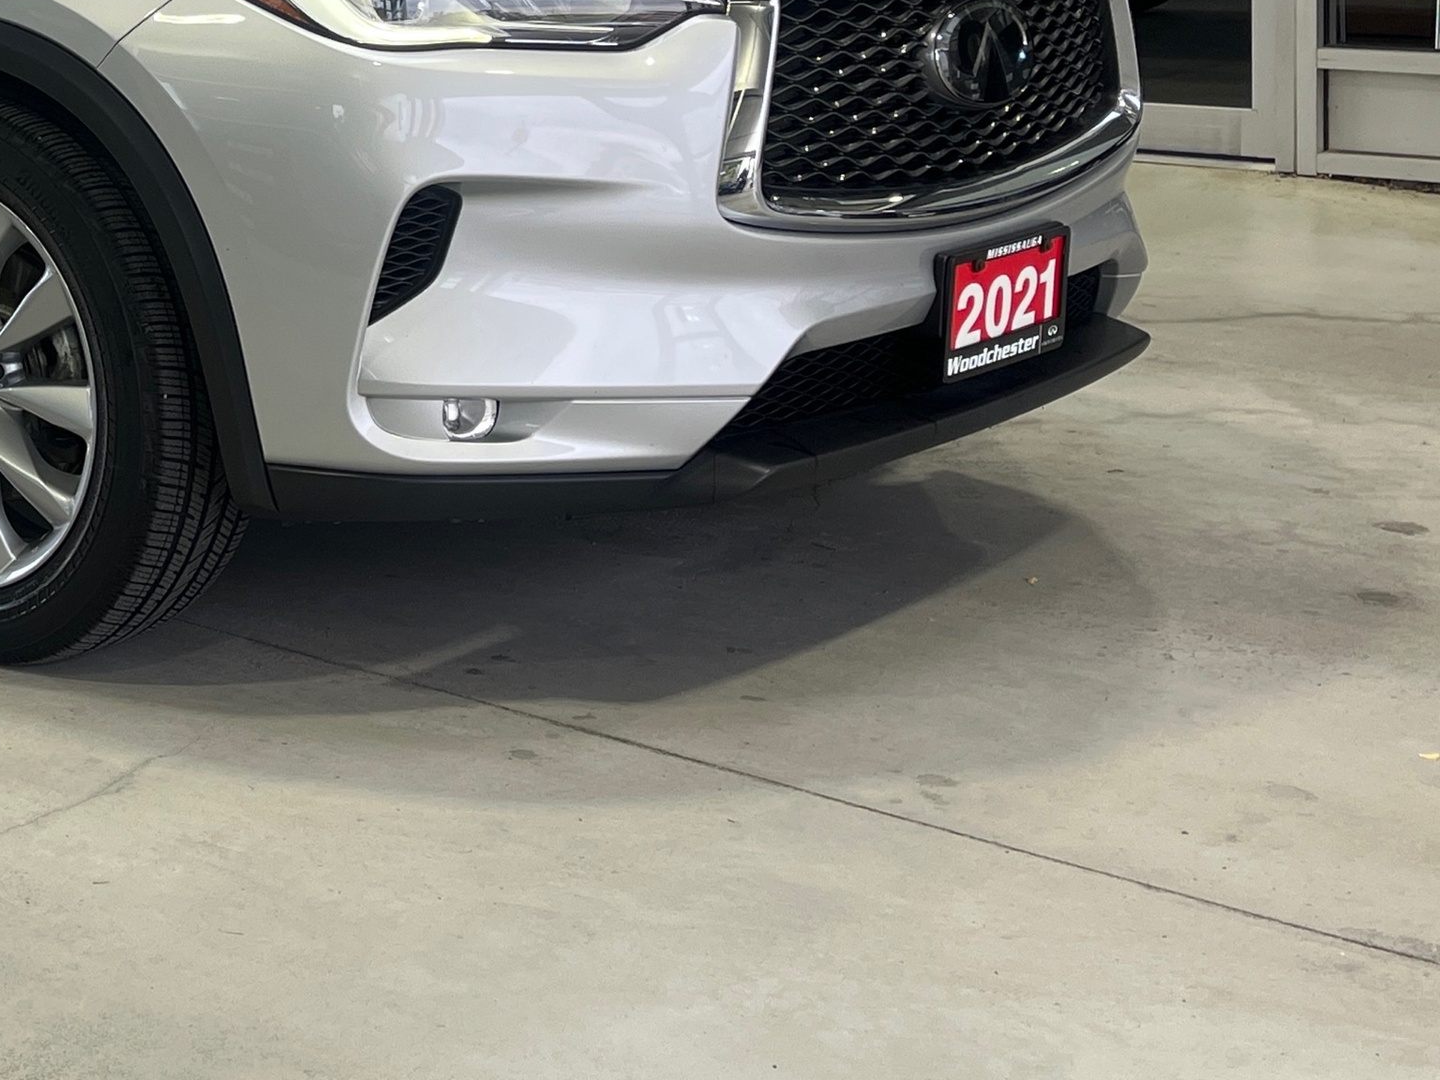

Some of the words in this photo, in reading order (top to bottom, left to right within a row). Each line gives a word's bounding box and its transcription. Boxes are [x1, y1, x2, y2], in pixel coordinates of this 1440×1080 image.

[986, 235, 1042, 260] MISSISSAUGA
[954, 258, 1056, 350] 2021
[947, 335, 1039, 376] Woodchester
